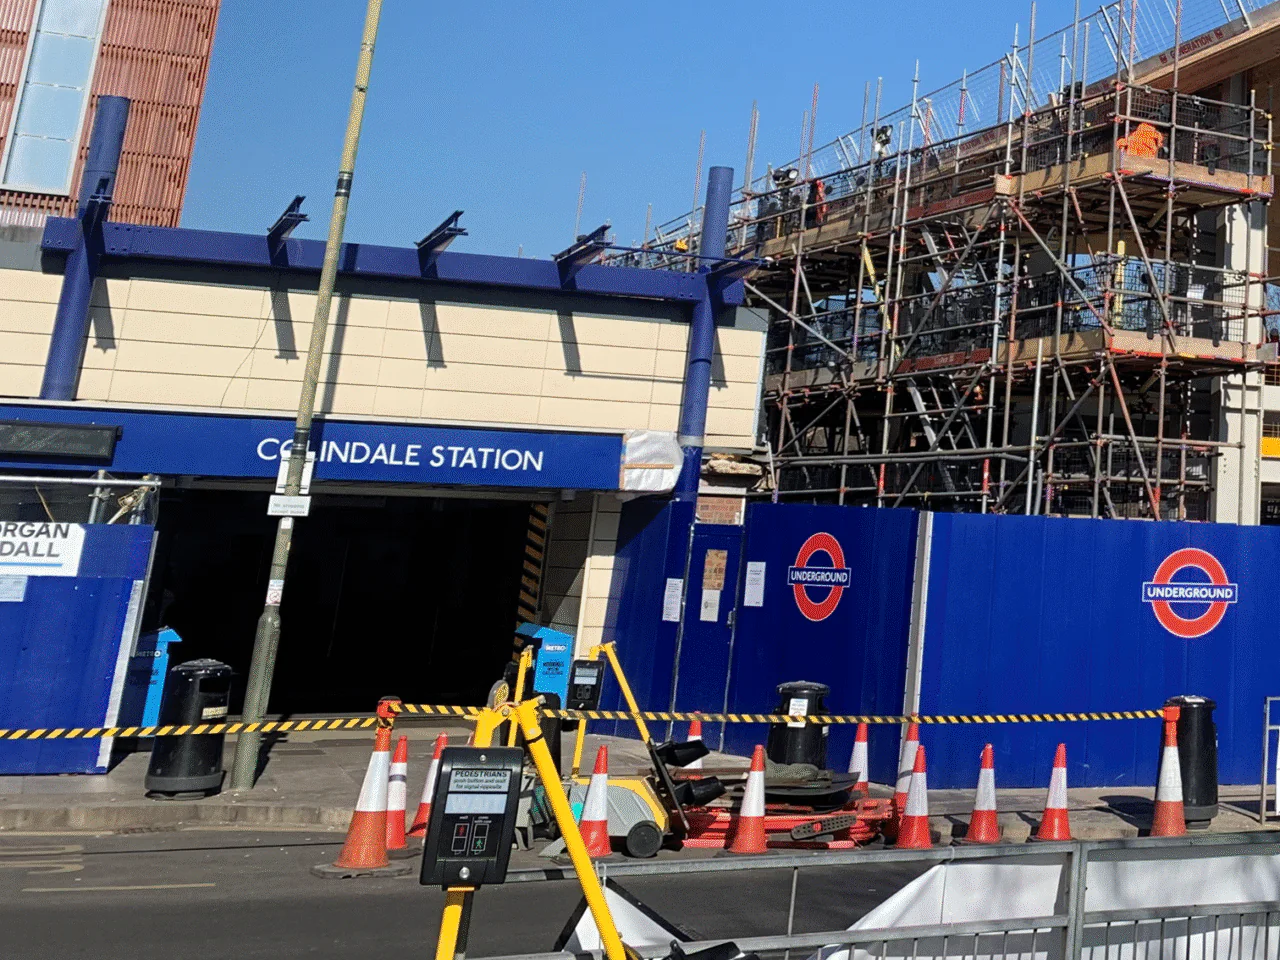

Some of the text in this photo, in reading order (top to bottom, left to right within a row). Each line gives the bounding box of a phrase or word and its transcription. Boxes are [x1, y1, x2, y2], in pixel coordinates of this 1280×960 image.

[1170, 35, 1212, 58] GNERATION
[429, 445, 544, 471] STATION
[0, 522, 70, 539] RGAN
[0, 541, 60, 557] DALL
[790, 570, 848, 583] UNDERGROUND
[1147, 587, 1234, 599] UNDERGROUND
